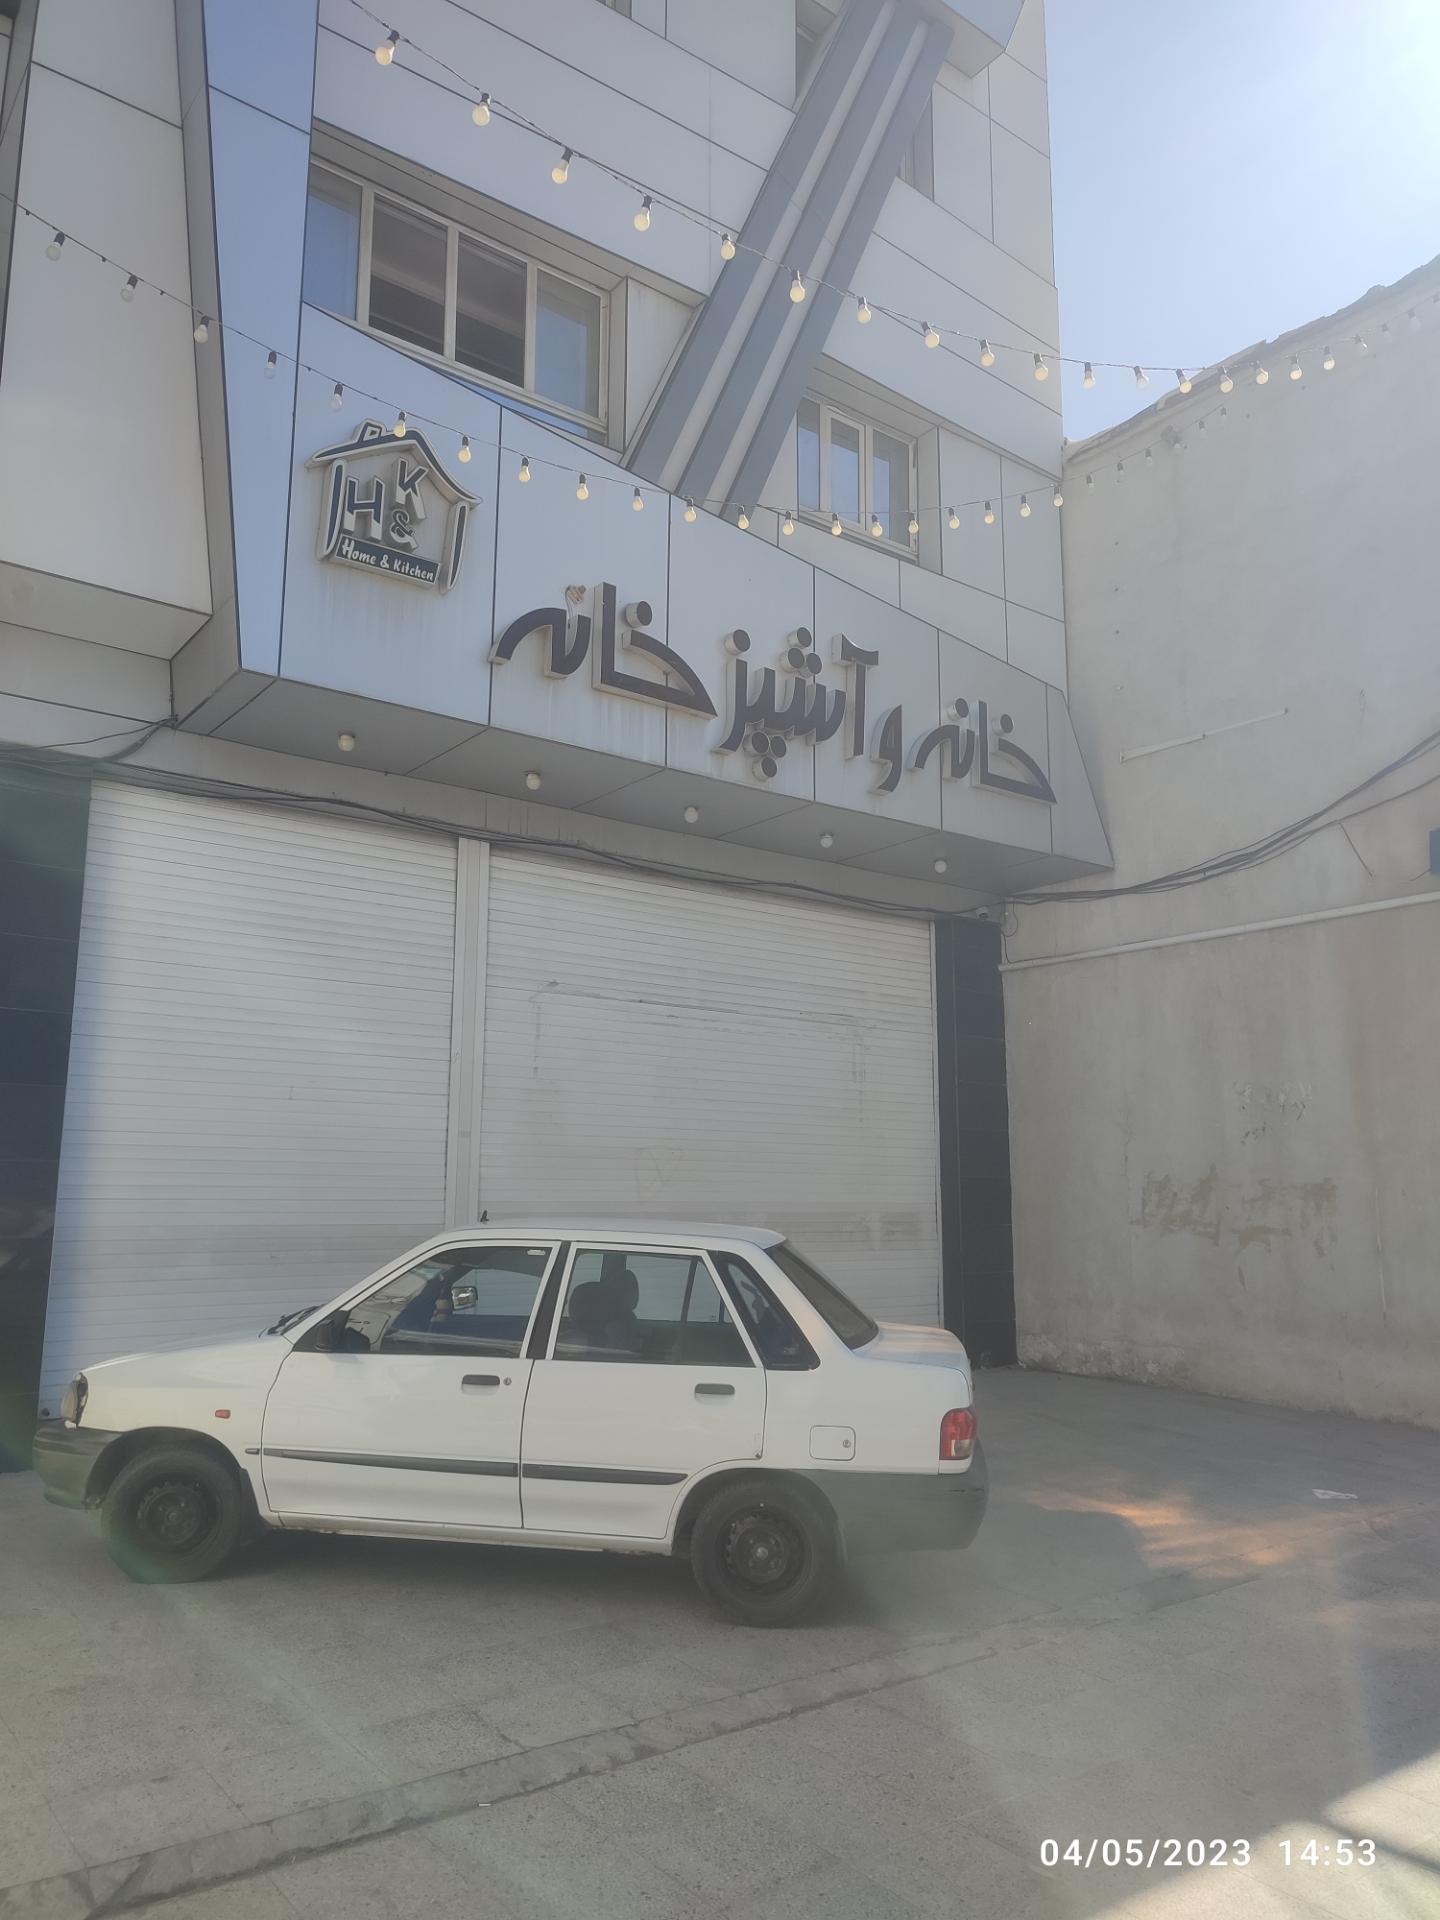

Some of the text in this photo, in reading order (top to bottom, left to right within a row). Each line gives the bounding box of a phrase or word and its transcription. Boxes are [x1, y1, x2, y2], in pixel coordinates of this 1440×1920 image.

[342, 538, 434, 581] Home & Kitchen
[871, 704, 903, 794] و
[907, 698, 1057, 805] خانه
